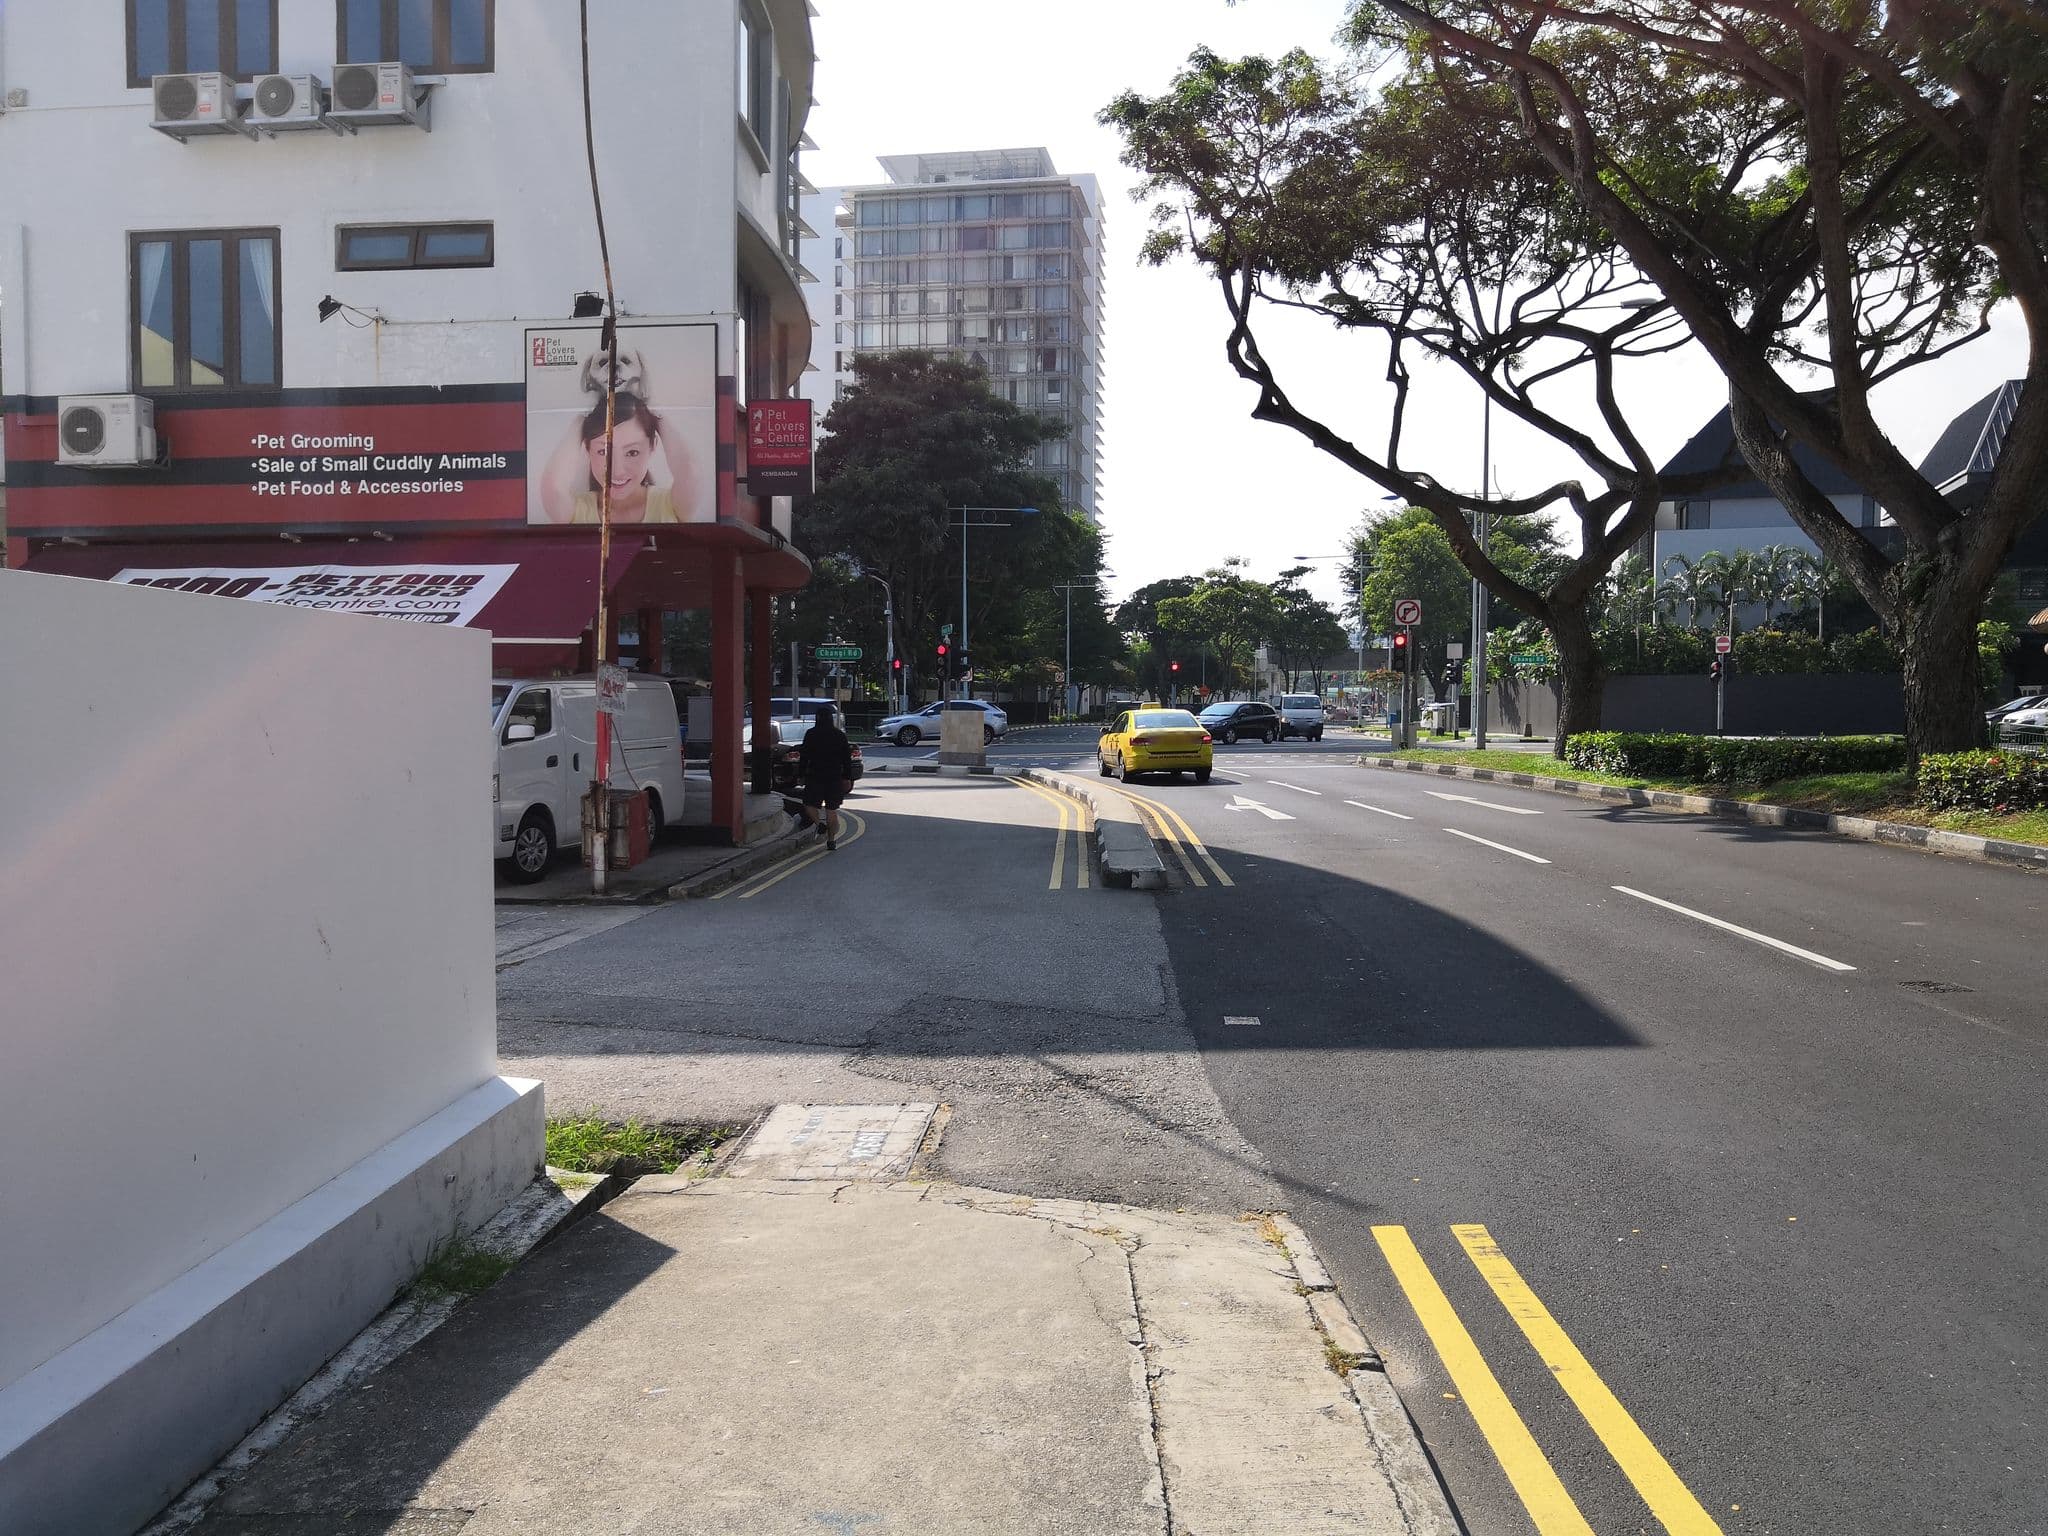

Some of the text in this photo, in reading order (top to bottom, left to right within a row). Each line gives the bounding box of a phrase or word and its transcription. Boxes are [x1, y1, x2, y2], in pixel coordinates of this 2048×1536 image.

[546, 337, 561, 346] Pet
[767, 409, 786, 420] Pet
[767, 421, 805, 432] Lovers
[257, 432, 374, 451] Pet Grooming
[767, 432, 805, 443] Centre
[258, 453, 507, 474] Sale of Small Cuddly Animals
[258, 477, 464, 496] Pet Food & Accessories
[287, 574, 485, 585] PETFOOD
[820, 649, 846, 658] Changi
